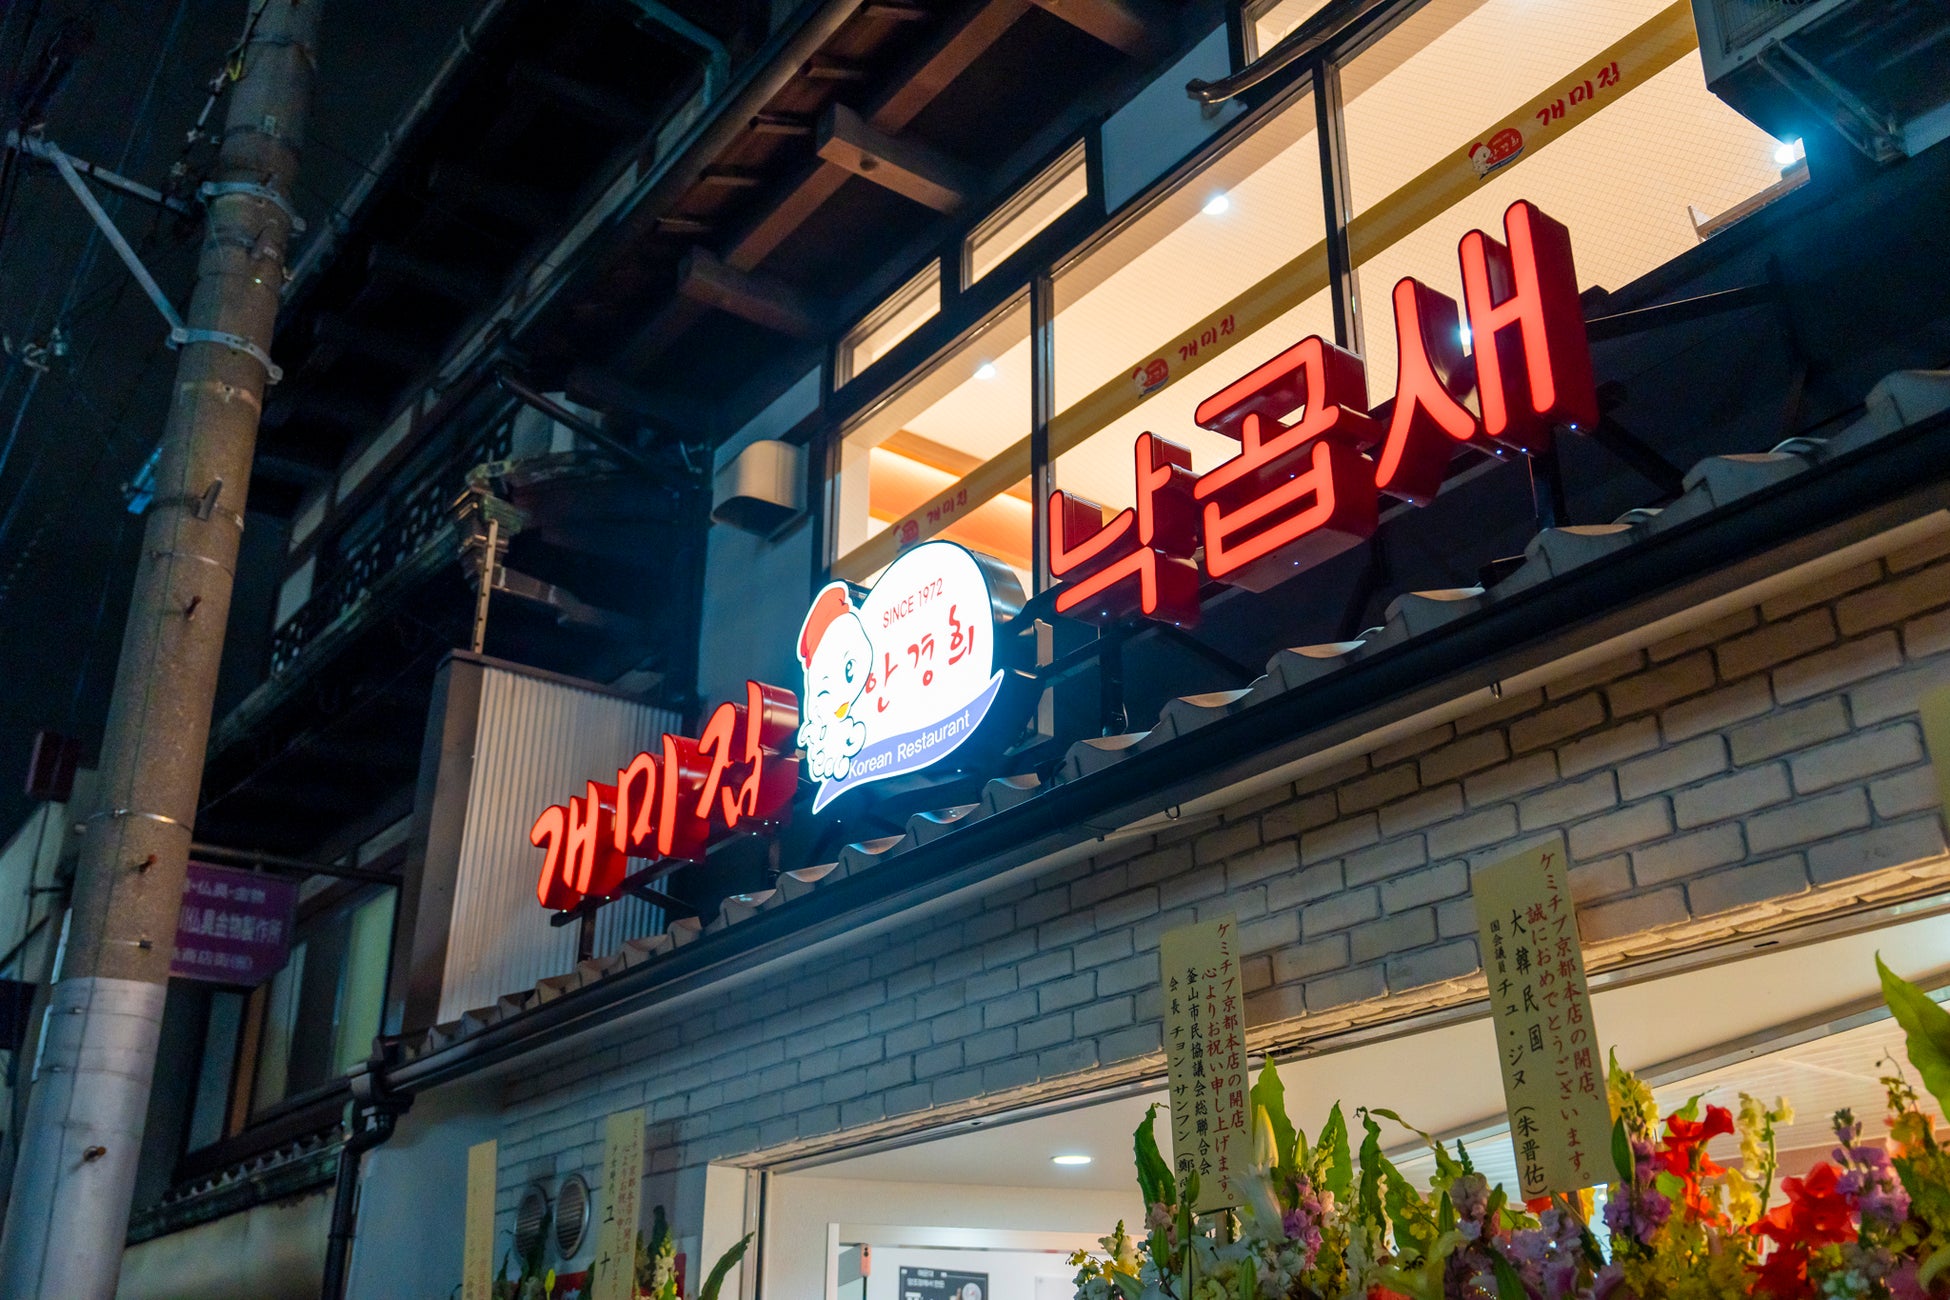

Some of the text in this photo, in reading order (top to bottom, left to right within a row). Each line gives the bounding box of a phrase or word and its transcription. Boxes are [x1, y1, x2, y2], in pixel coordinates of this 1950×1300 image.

[1535, 62, 1620, 126] 개미집
[1049, 199, 1557, 616] 낙곱새
[865, 604, 975, 713] 안경희
[883, 577, 943, 629] SINCE 1972
[530, 680, 764, 908] 개미집
[849, 710, 970, 778] Korean Restaurant
[1511, 909, 1544, 1052] 大韓民国
[1526, 902, 1590, 1180] 誠におめでとうございます。
[1201, 968, 1234, 1200] 心よりお祝い申し上げます。
